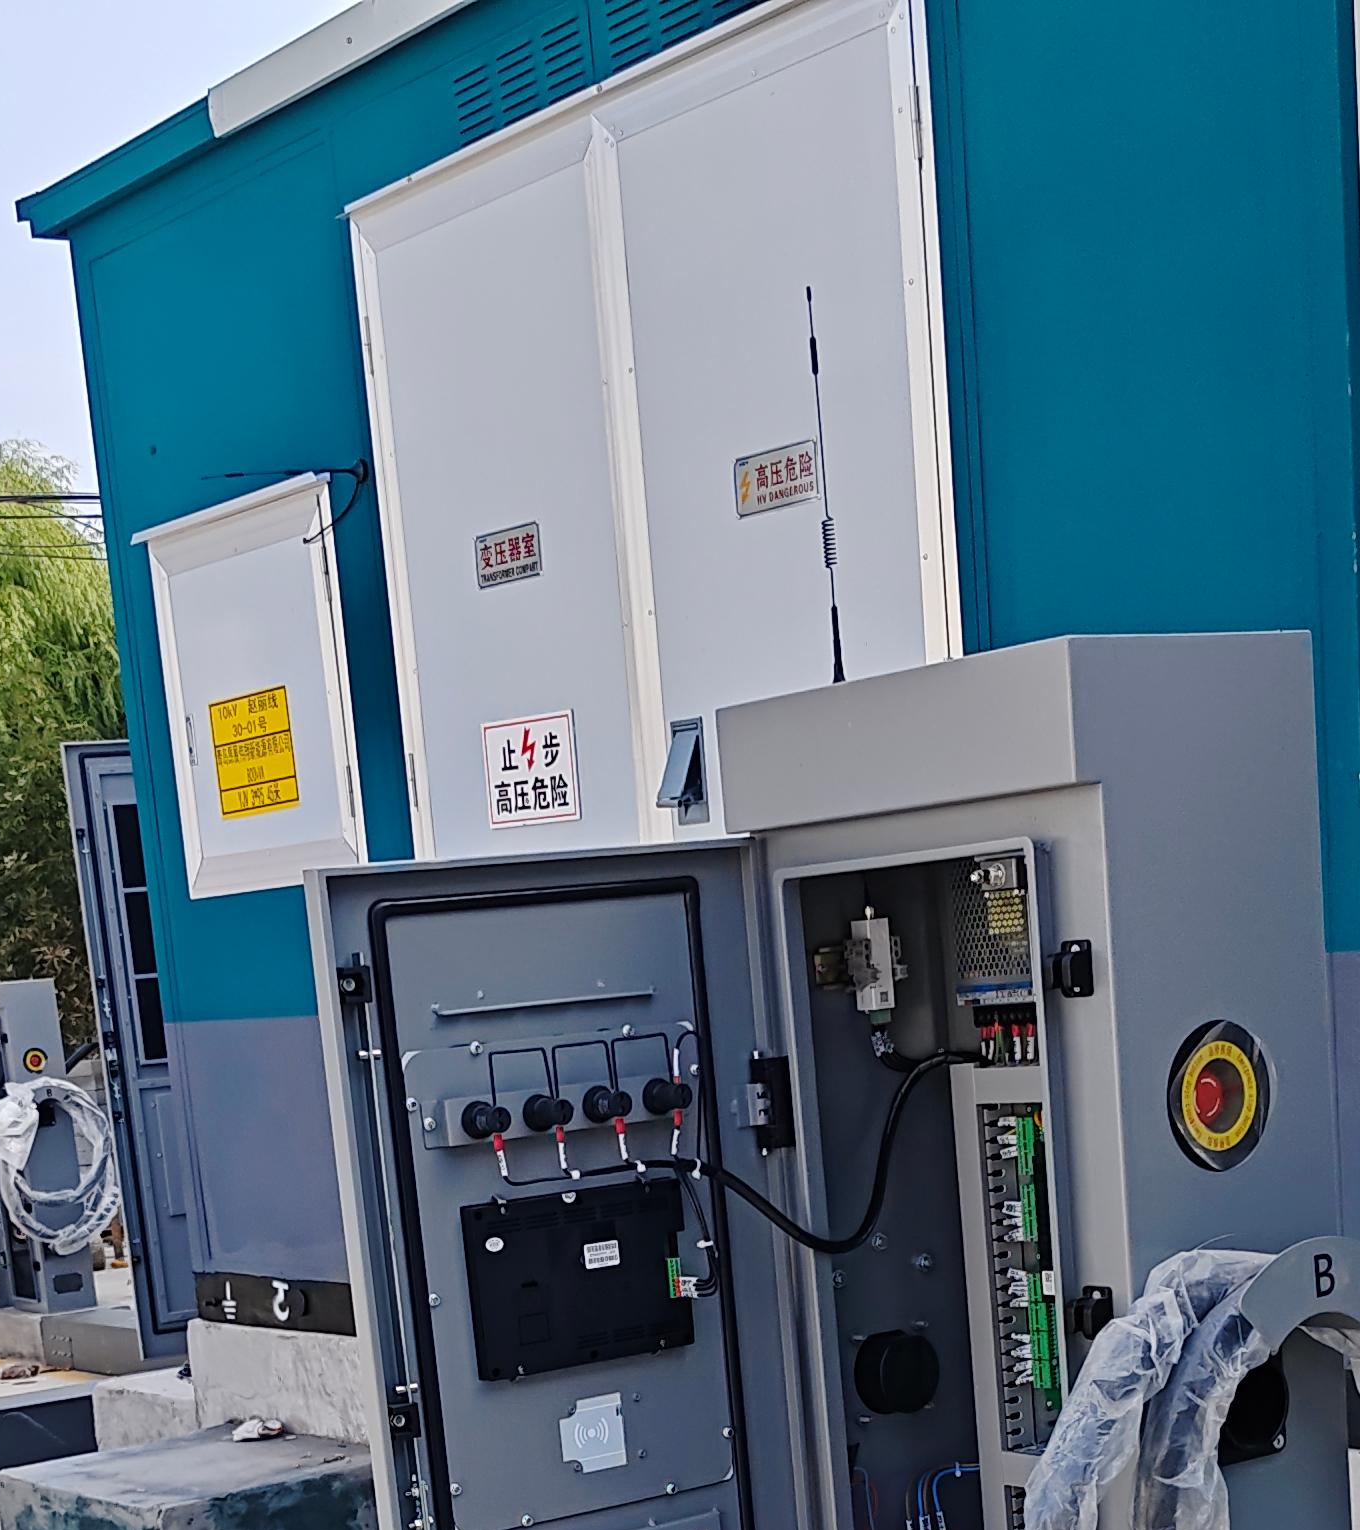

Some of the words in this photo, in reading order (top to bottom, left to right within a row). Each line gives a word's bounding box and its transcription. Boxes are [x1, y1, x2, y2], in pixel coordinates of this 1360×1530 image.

[755, 451, 814, 491] 高压危险
[769, 481, 814, 502] DANGEROUS
[480, 533, 536, 570] 变压器室
[218, 704, 237, 720] 10kV
[494, 773, 570, 815] 高压危险
[1314, 1253, 1335, 1298] B
